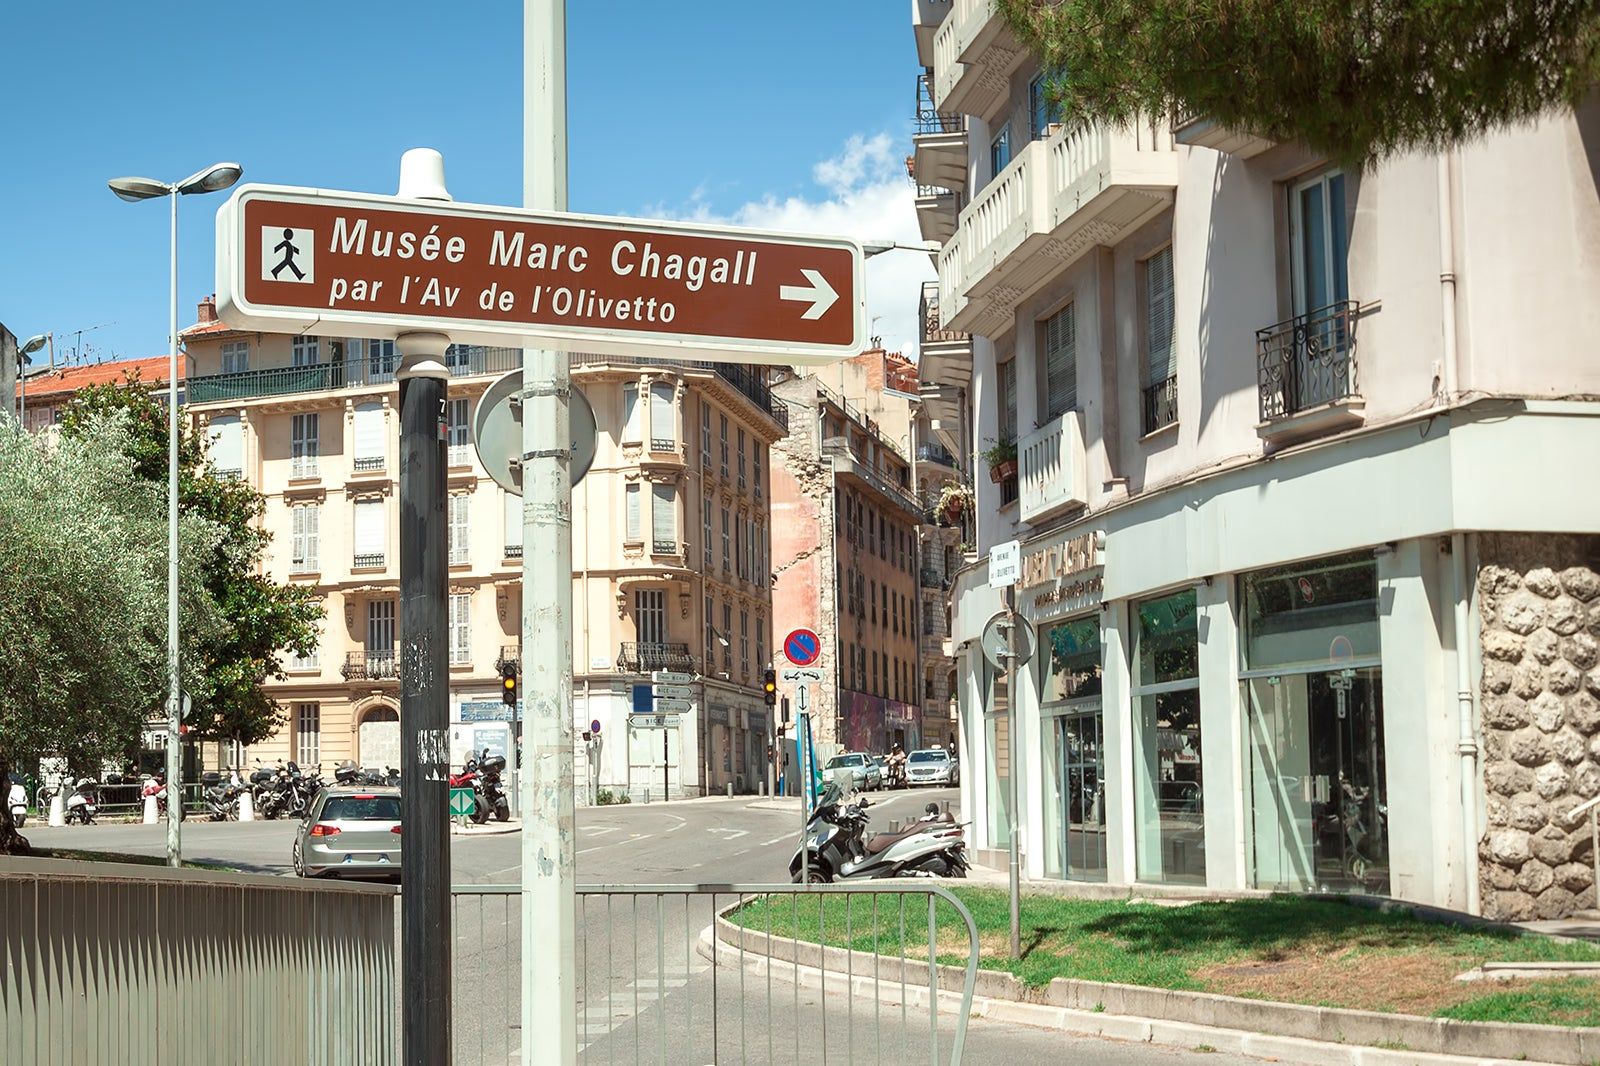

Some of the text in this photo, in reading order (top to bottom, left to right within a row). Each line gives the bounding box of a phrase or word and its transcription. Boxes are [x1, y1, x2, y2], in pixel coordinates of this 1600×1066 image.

[330, 216, 757, 292] Musée Marc Chagall
[328, 275, 676, 323] par l'Av de l'Olivetto
